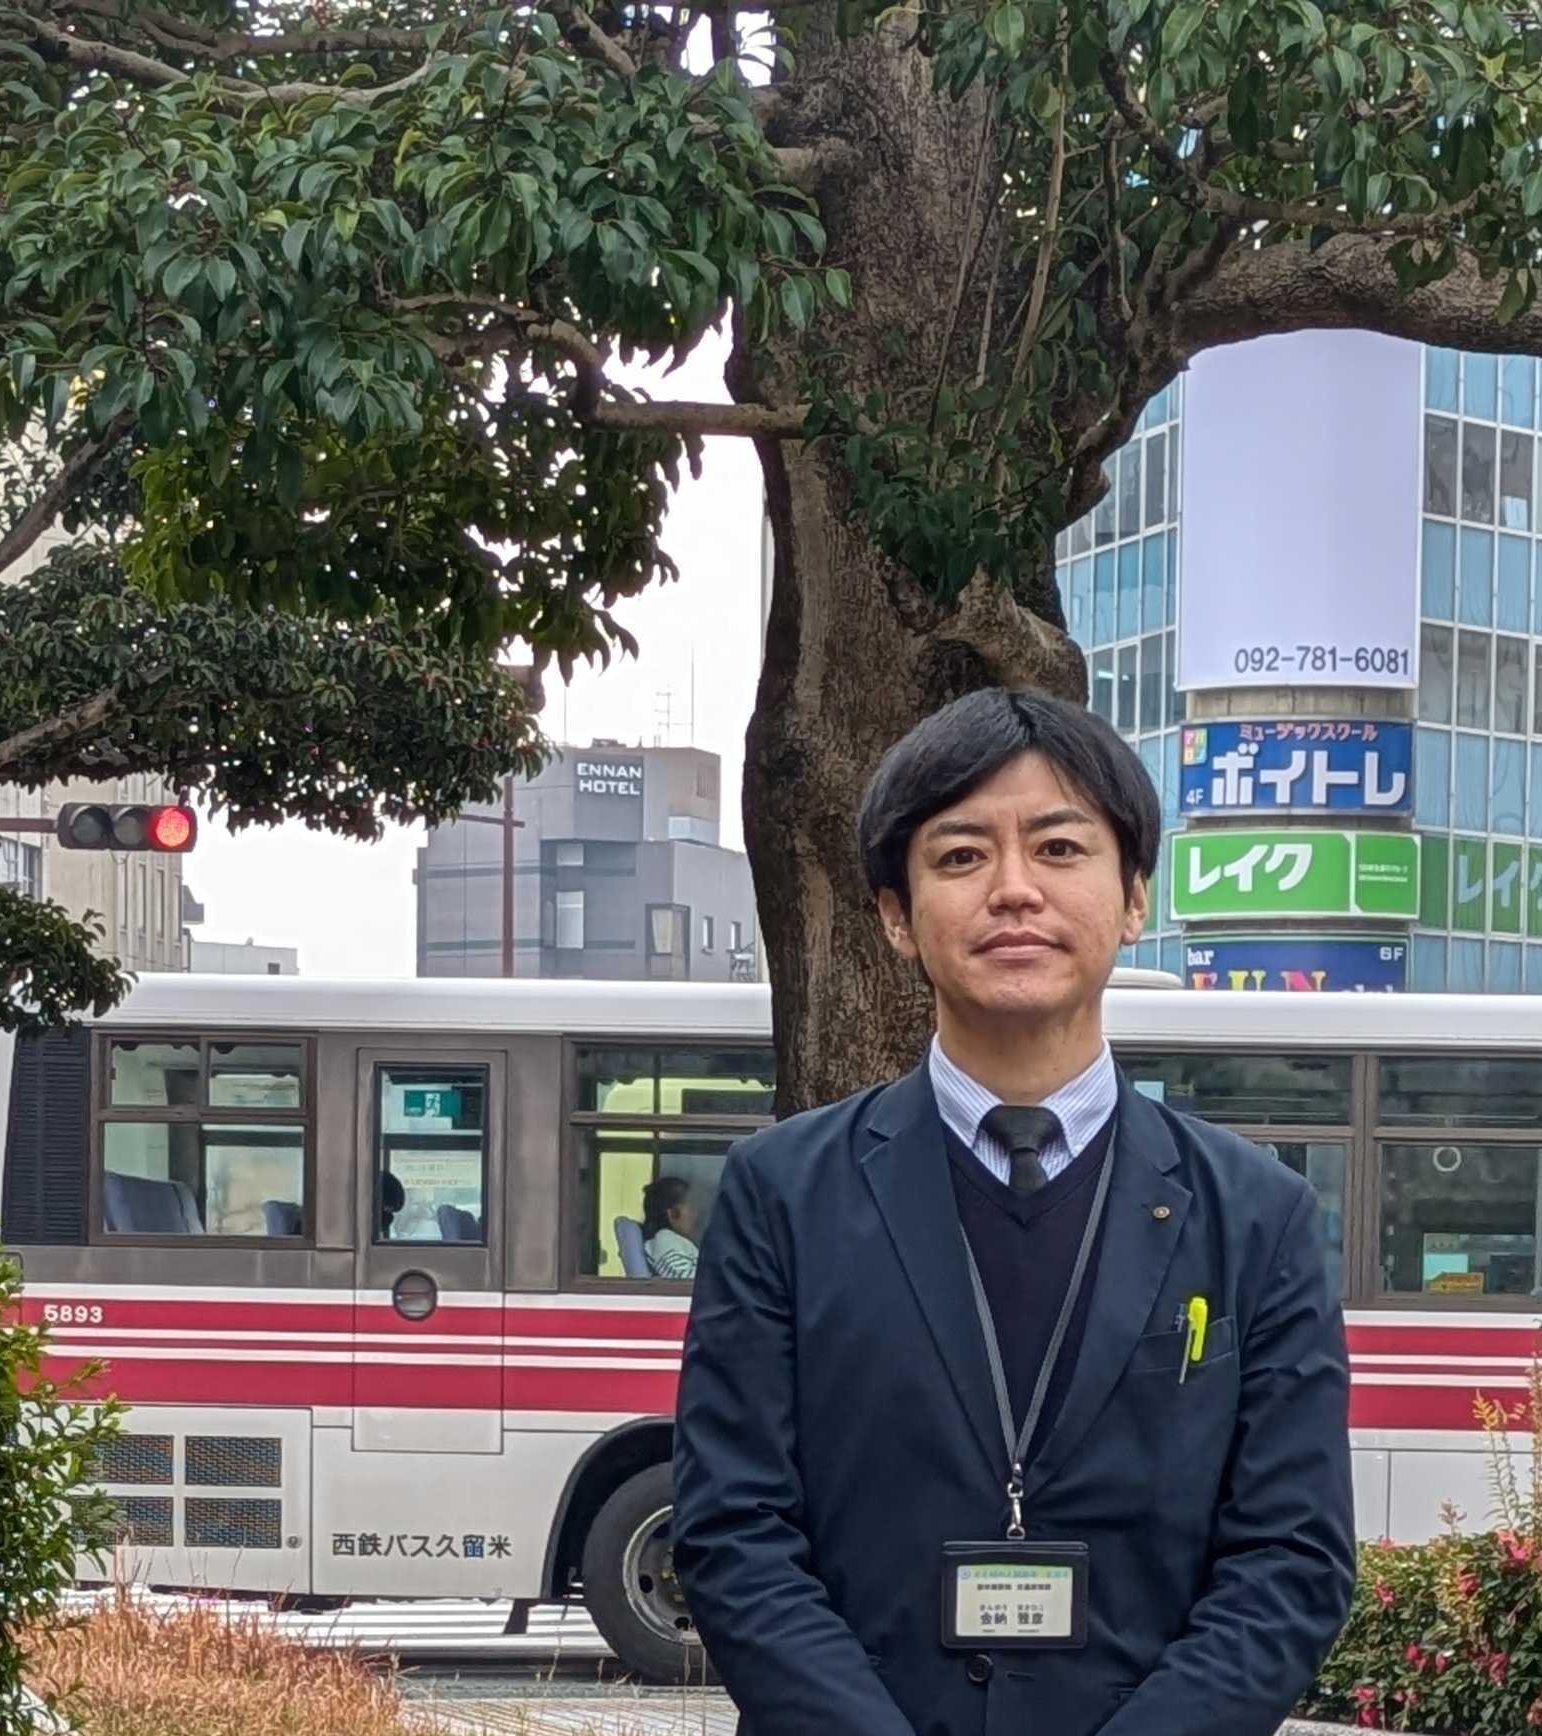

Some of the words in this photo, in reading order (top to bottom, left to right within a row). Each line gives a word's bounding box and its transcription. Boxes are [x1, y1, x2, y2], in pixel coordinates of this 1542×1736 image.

[1234, 645, 1410, 675] 092-781-6081
[576, 762, 643, 779] ENNAN
[1212, 743, 1406, 805] ボイトレ
[578, 780, 641, 796] HOTEL
[1185, 788, 1204, 804] 4F
[1188, 843, 1313, 894] レイク
[44, 1304, 104, 1324] 5893
[332, 1532, 513, 1560] 西鉄バス久留米
